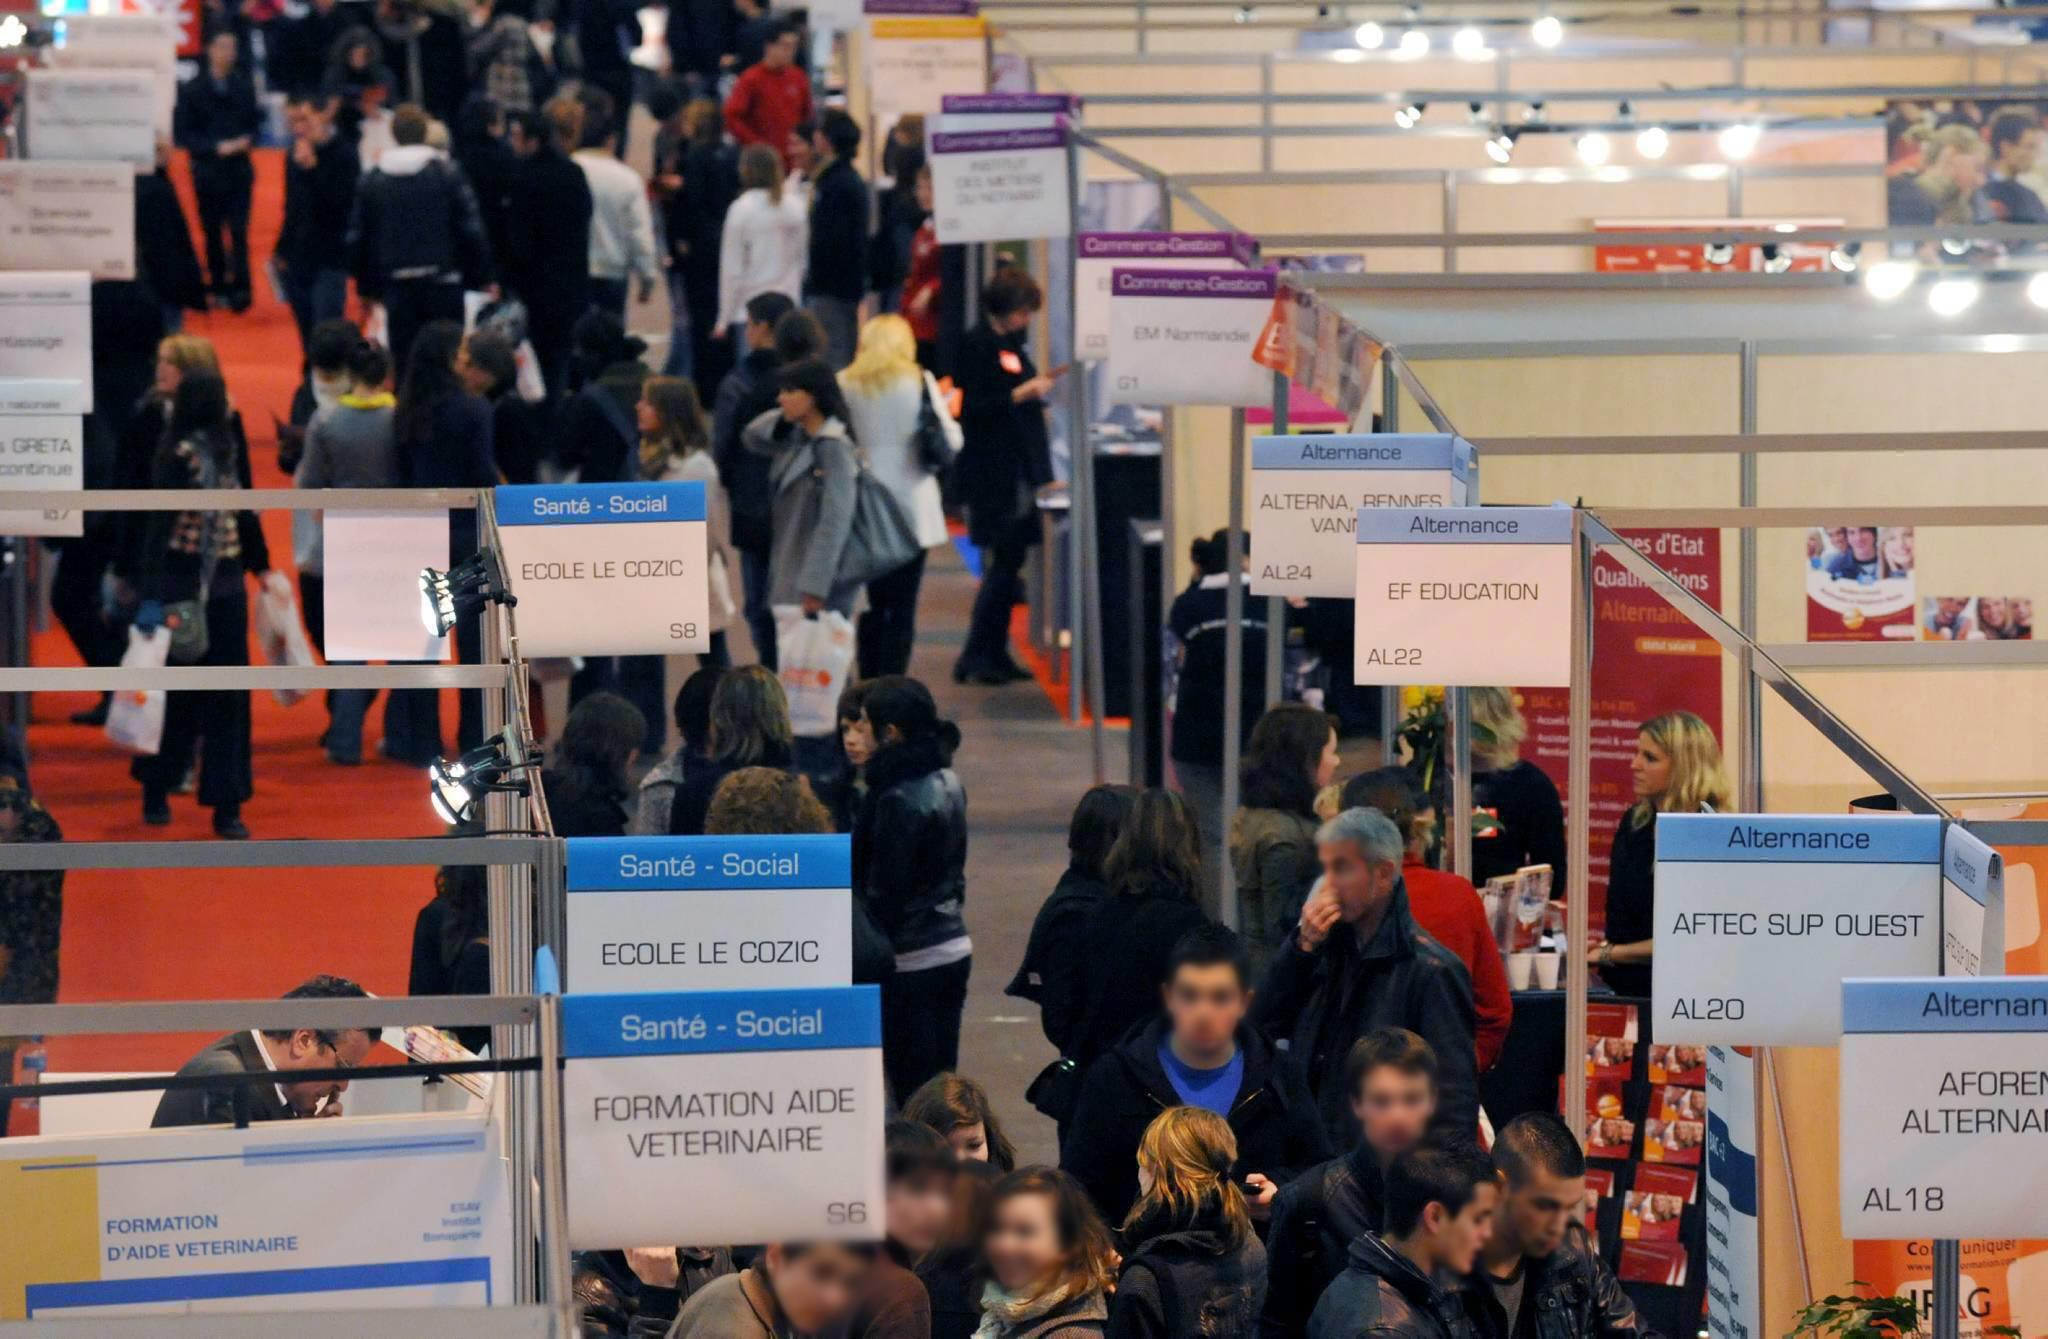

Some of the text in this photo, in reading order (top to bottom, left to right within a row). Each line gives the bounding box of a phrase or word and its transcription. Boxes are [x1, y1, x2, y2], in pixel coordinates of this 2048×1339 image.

[1085, 237, 1226, 252] Commerce-Gestion
[1119, 273, 1268, 292] Commerce-Gestion
[1133, 326, 1250, 343] EM Normandie
[1118, 376, 1138, 390] G1
[12, 438, 72, 453] GRETA
[1300, 443, 1402, 461] Alternance
[0, 462, 73, 476] continue
[534, 498, 591, 516] Santé
[609, 495, 668, 514] Social
[1409, 516, 1519, 534] Alternance
[1655, 533, 1705, 556] d'Etat
[522, 559, 684, 581] ECOLE LE COZIC
[1262, 565, 1313, 581] AL24
[1388, 583, 1538, 601] EF EDUCATION
[670, 623, 697, 640] S8
[1367, 648, 1422, 666] AL22
[1728, 826, 1871, 849] Alternance
[620, 854, 695, 878] Santé
[723, 852, 799, 876] Social
[1673, 913, 1924, 937] AFTEC SUP OUEST
[602, 940, 820, 966] ECOLE LE COZIC
[1671, 998, 1745, 1020] AL20
[621, 1013, 707, 1042] Santé
[736, 1008, 823, 1036] Social
[594, 1088, 856, 1123] FORMATION AIDE
[627, 1126, 823, 1158] VETERINAIRE
[1862, 1187, 1945, 1212] AL18
[826, 1202, 867, 1225] S6
[106, 1214, 219, 1235] FORMATION
[107, 1236, 298, 1262] D'AIDE VETERINAIRE
